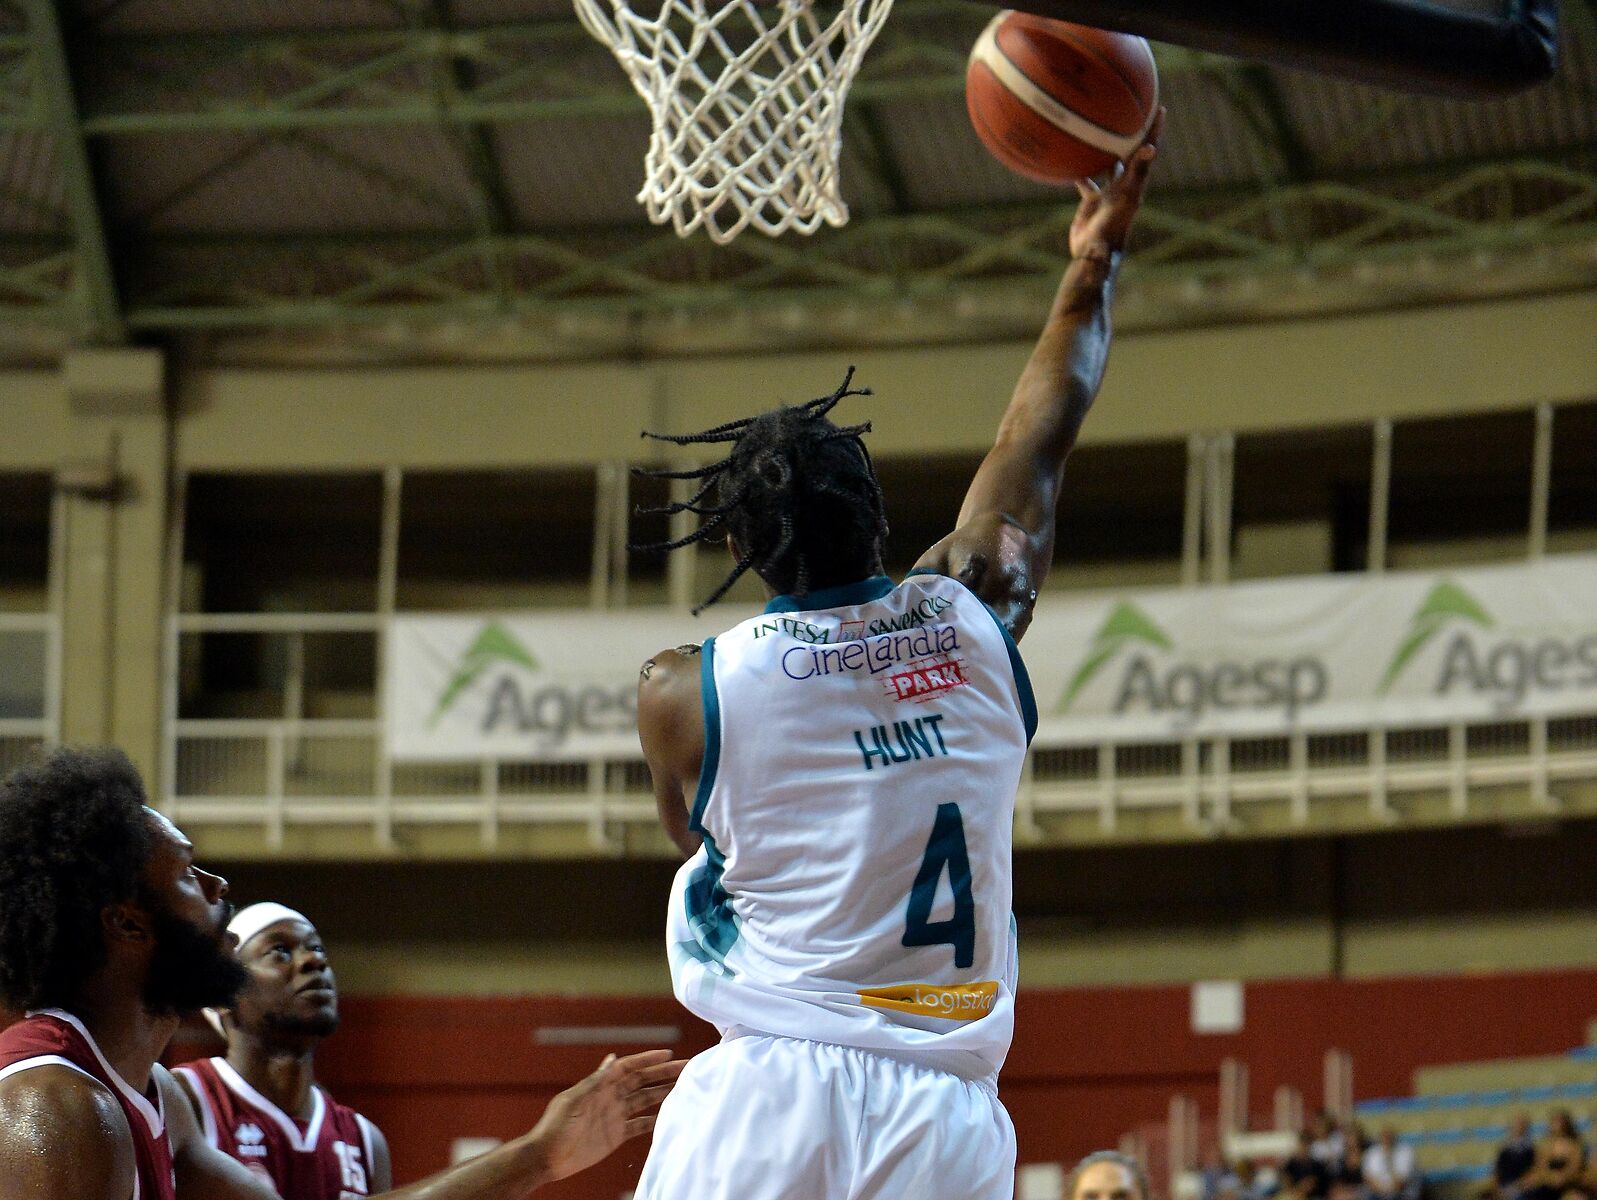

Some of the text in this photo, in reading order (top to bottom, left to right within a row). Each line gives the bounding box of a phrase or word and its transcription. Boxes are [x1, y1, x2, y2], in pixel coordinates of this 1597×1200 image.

[753, 617, 831, 644] INTESA
[899, 663, 963, 697] PARK
[1113, 652, 1329, 731] Agesp
[1434, 629, 1597, 711] Ages
[482, 673, 639, 752] Ages
[854, 714, 948, 770] HUNT
[902, 802, 976, 968] 4
[333, 1141, 368, 1194] 15
